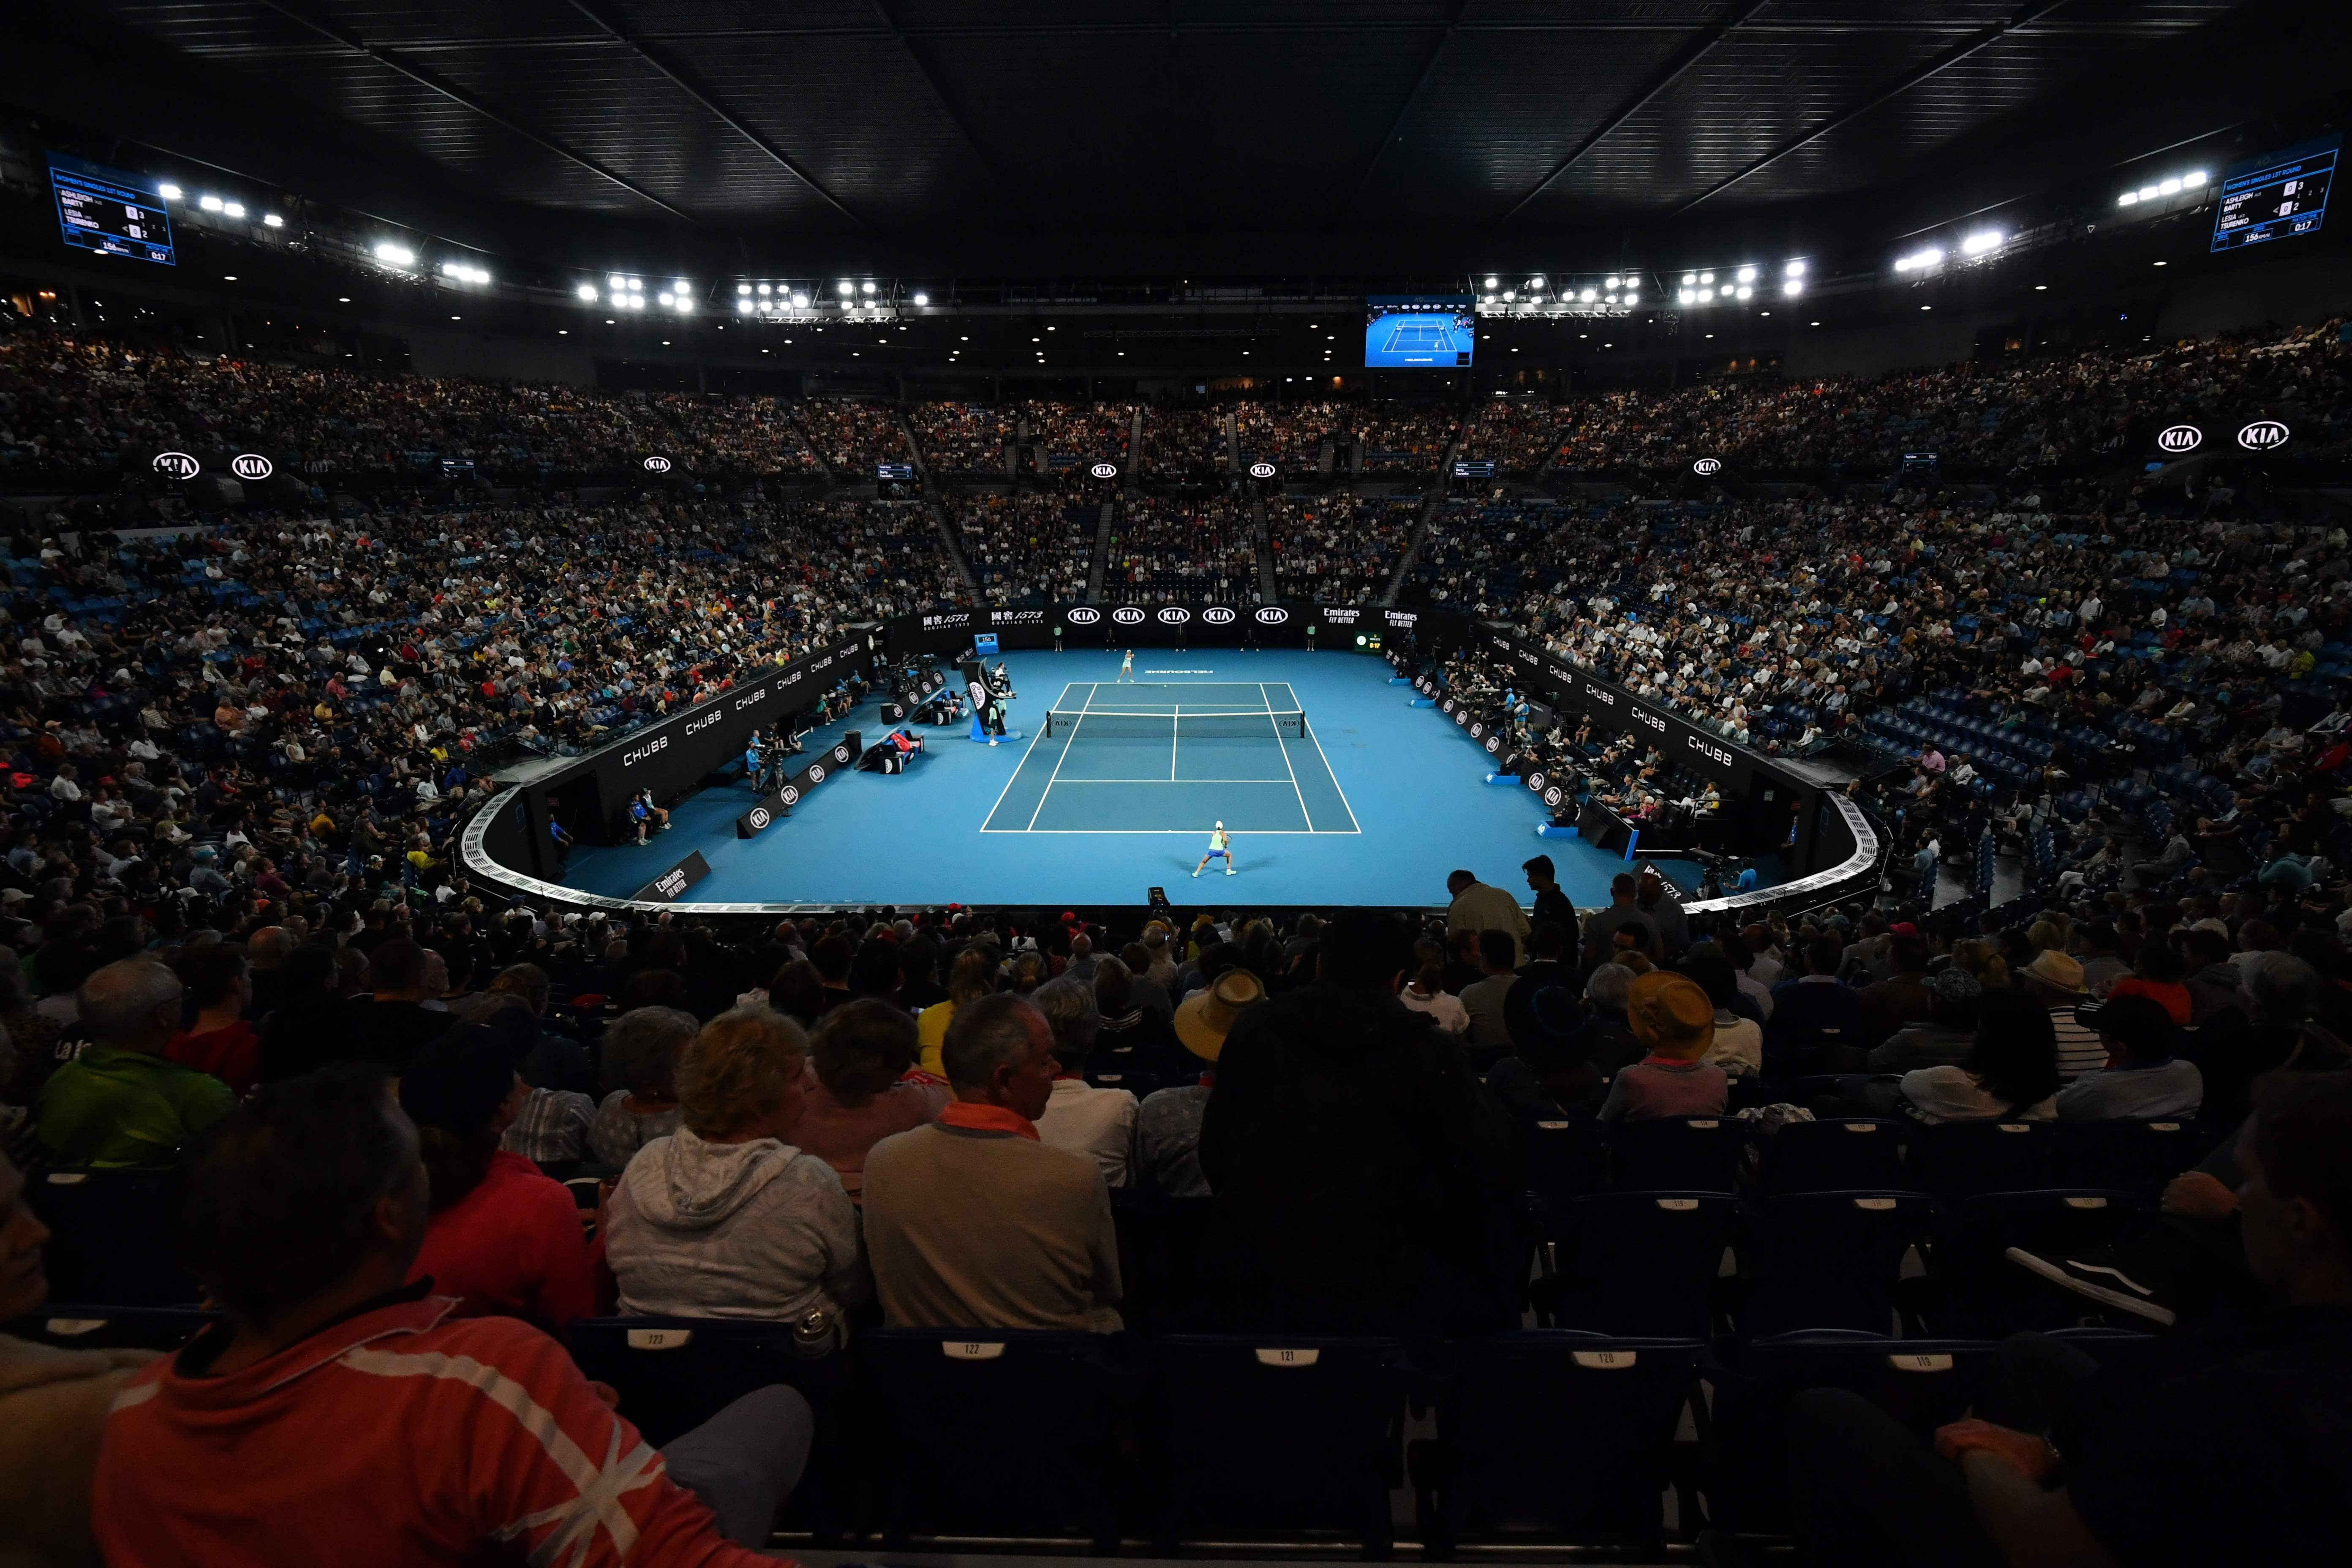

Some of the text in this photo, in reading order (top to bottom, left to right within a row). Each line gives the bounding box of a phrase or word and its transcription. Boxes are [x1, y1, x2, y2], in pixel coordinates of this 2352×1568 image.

[2298, 181, 2304, 190] 3
[2225, 192, 2254, 205] ASHLEIGH
[2224, 202, 2242, 212] BARTY
[2293, 202, 2299, 211] 2
[2221, 214, 2237, 223] LESIA
[2221, 218, 2249, 229] TSURENKO
[2295, 221, 2311, 231] 0:17
[2245, 233, 2258, 242] 156
[151, 252, 166, 261] 0:17
[2165, 431, 2194, 446] KIA
[2246, 427, 2279, 444] KIA
[238, 460, 267, 474] KIA
[648, 460, 667, 469] KIA
[1698, 462, 1716, 471] KIA
[1096, 467, 1112, 475] KIA
[1254, 467, 1271, 475] KIA
[1073, 611, 1095, 621] KIA
[1119, 611, 1140, 621] KIA
[1163, 611, 1184, 621] KIA
[1208, 611, 1230, 621] KIA
[1261, 611, 1282, 621] KIA
[1324, 608, 1360, 617] Emirates
[1385, 610, 1417, 621] Emirates
[1397, 620, 1413, 628] BETTER
[1493, 636, 1510, 650] CHUBB
[840, 643, 858, 658] CHUBB
[1519, 649, 1538, 665] CHUBB
[811, 656, 832, 672] CHUBB
[1549, 665, 1572, 683] CHUBB
[777, 671, 801, 690] CHUBB
[736, 689, 765, 710] CHUBB
[1586, 684, 1614, 705] CHUBB
[686, 710, 721, 735] CHUBB
[1632, 707, 1666, 732] CHUBB
[623, 736, 668, 766] CHUBB
[1688, 736, 1731, 766] CHUBB
[655, 868, 685, 893] Emirates
[666, 879, 687, 898] FLY BETTER
[648, 1334, 663, 1345] 123
[965, 1344, 980, 1354] 122
[1281, 1351, 1295, 1361] 121
[1599, 1353, 1614, 1364] 120
[1916, 1356, 1932, 1367] 119
